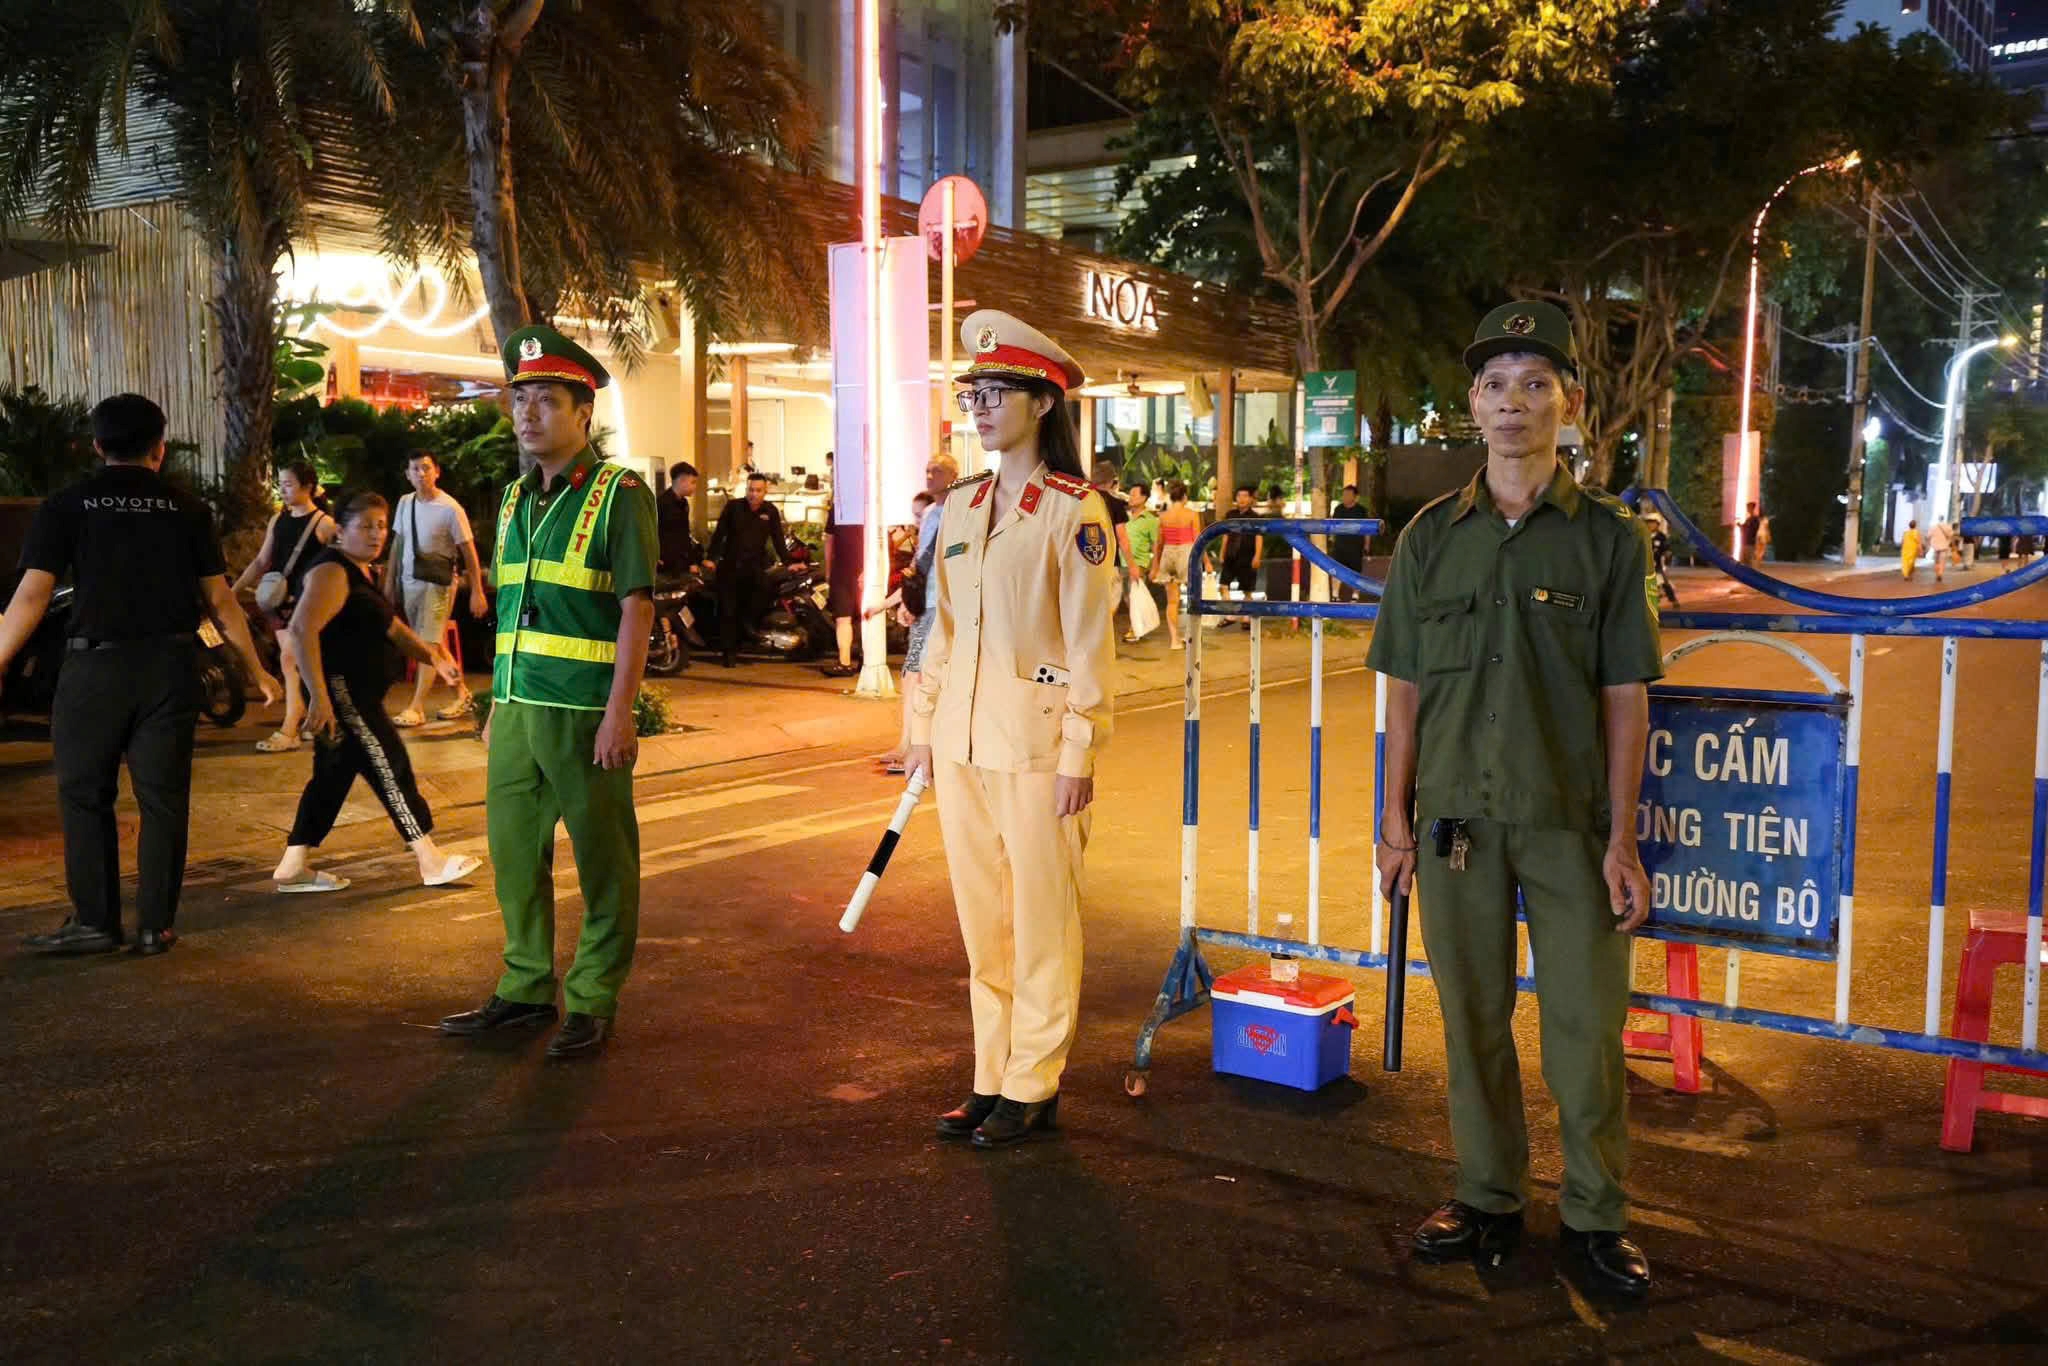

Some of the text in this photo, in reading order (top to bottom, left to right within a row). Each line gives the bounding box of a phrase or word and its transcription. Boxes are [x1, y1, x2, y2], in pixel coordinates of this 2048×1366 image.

[1087, 271, 1159, 331] NOA
[83, 496, 179, 511] NOVOTEL
[572, 469, 612, 553] CSTT
[1695, 717, 1788, 785] CẤM
[1636, 800, 1808, 862] ƠNG TIỆN
[1652, 867, 1820, 936] ĐƯỜNG BỘ
